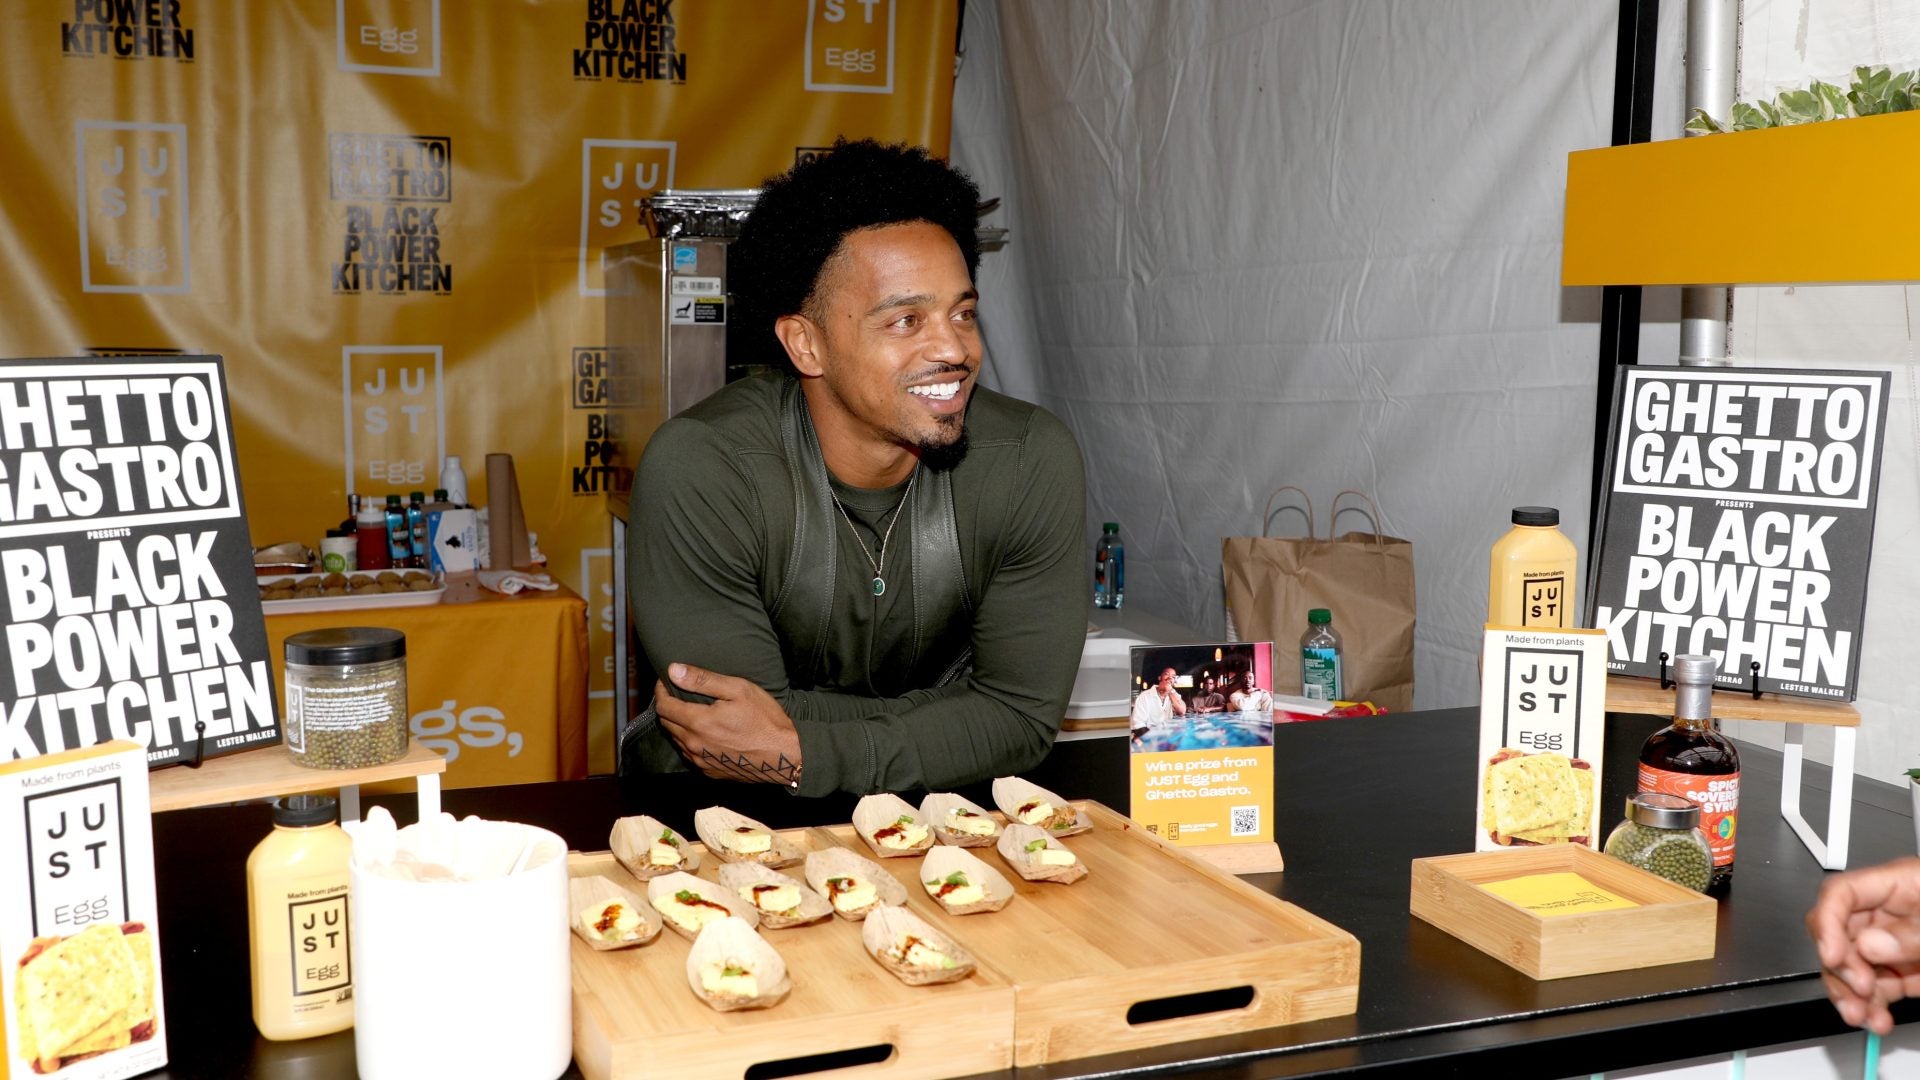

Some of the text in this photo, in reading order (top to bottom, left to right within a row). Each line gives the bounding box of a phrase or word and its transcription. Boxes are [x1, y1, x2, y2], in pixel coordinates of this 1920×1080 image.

[75, 0, 181, 28] POWER
[588, 0, 673, 24] BLACK
[62, 22, 194, 58] KITCHEN
[360, 25, 418, 54] Egg
[586, 21, 676, 53] POWER
[574, 49, 686, 81] KITCHEN
[825, 47, 876, 73] Egg
[336, 138, 446, 170] GHETTO
[338, 167, 446, 197] GASTRO
[346, 206, 440, 235] BLACK
[106, 246, 168, 272] Egg
[344, 234, 441, 263] POWER
[331, 262, 452, 291] KITCHEN
[0, 376, 213, 449] HETTO
[1635, 381, 1865, 441] GHETTO
[368, 459, 425, 484] Egg
[1629, 432, 1858, 496] GASTRO
[1715, 499, 1754, 509] PRESENTS
[87, 528, 131, 540] PRESENTS
[1637, 503, 1838, 571] BLACK
[1, 531, 228, 622] BLACK
[1624, 555, 1831, 628] POWER
[6, 599, 243, 697] POWER
[1505, 634, 1585, 647] Made from plants
[1596, 605, 1852, 688] KITCHEN
[1780, 682, 1845, 697] LESTER WALKER
[0, 660, 276, 762] KITCHEN
[216, 735, 245, 748] LESTER
[245, 729, 276, 744] WALKER
[1519, 730, 1563, 751] Egg
[147, 747, 179, 762] SERRAO
[1145, 756, 1257, 772] Win a prize from
[21, 761, 121, 788] Made from plants
[1145, 771, 1239, 787] JUST Egg and
[1145, 785, 1251, 801] Ghetto Gastro.
[327, 884, 348, 894] plants
[54, 895, 109, 925] Egg
[306, 963, 340, 981] Egg
